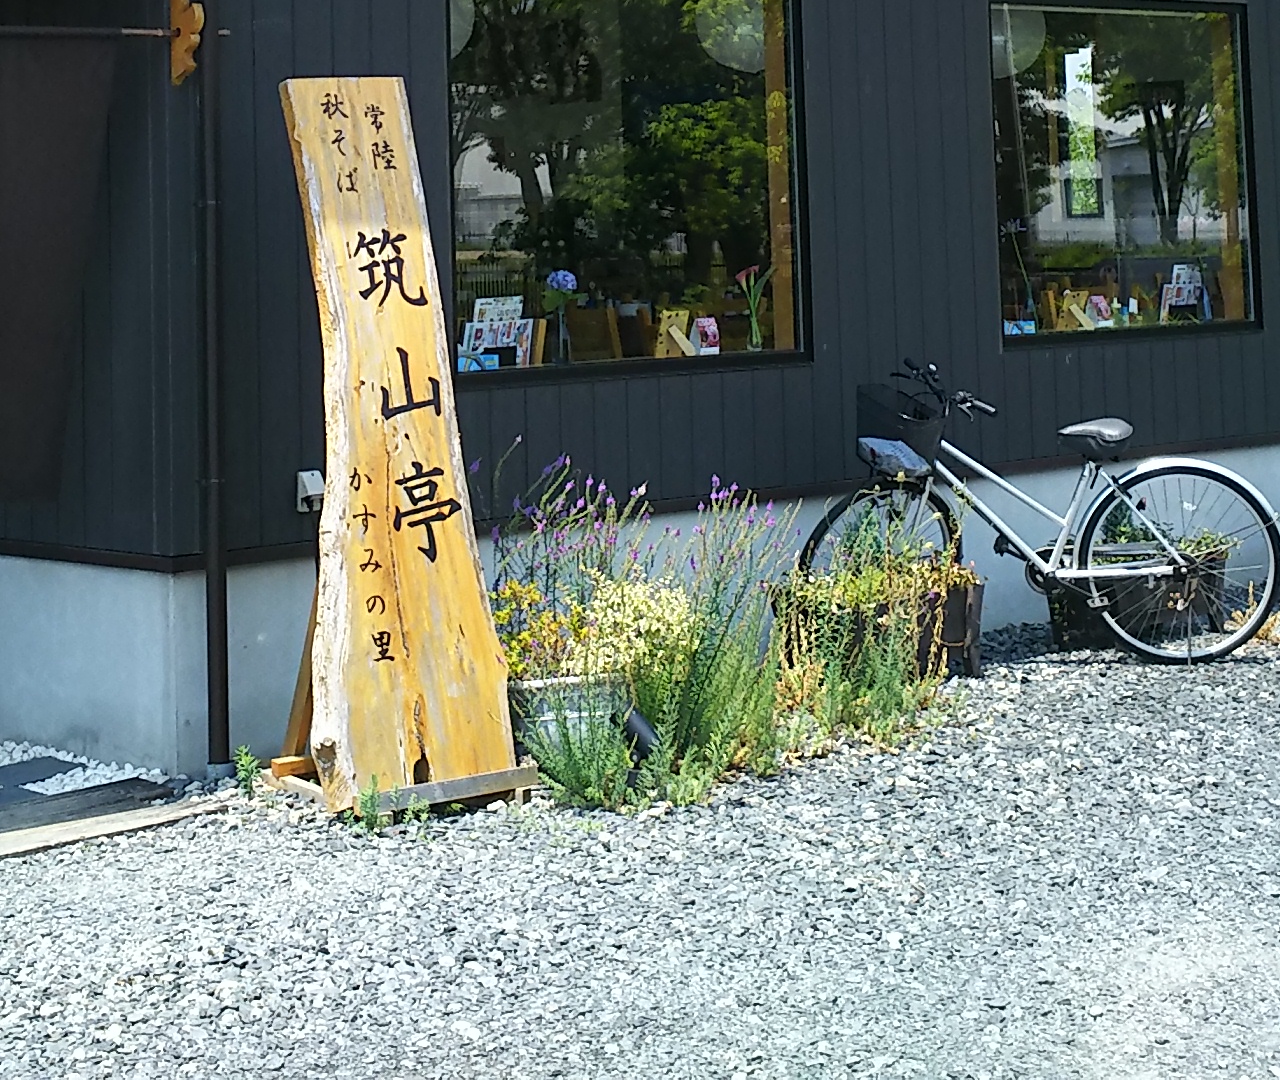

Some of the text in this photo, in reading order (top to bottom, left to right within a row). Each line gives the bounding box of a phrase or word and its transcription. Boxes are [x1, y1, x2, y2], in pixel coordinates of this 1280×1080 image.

[320, 93, 359, 193] 秋そば
[364, 104, 397, 170] 常陸
[353, 228, 463, 563] 筑山亭
[349, 467, 395, 663] かすみの里
